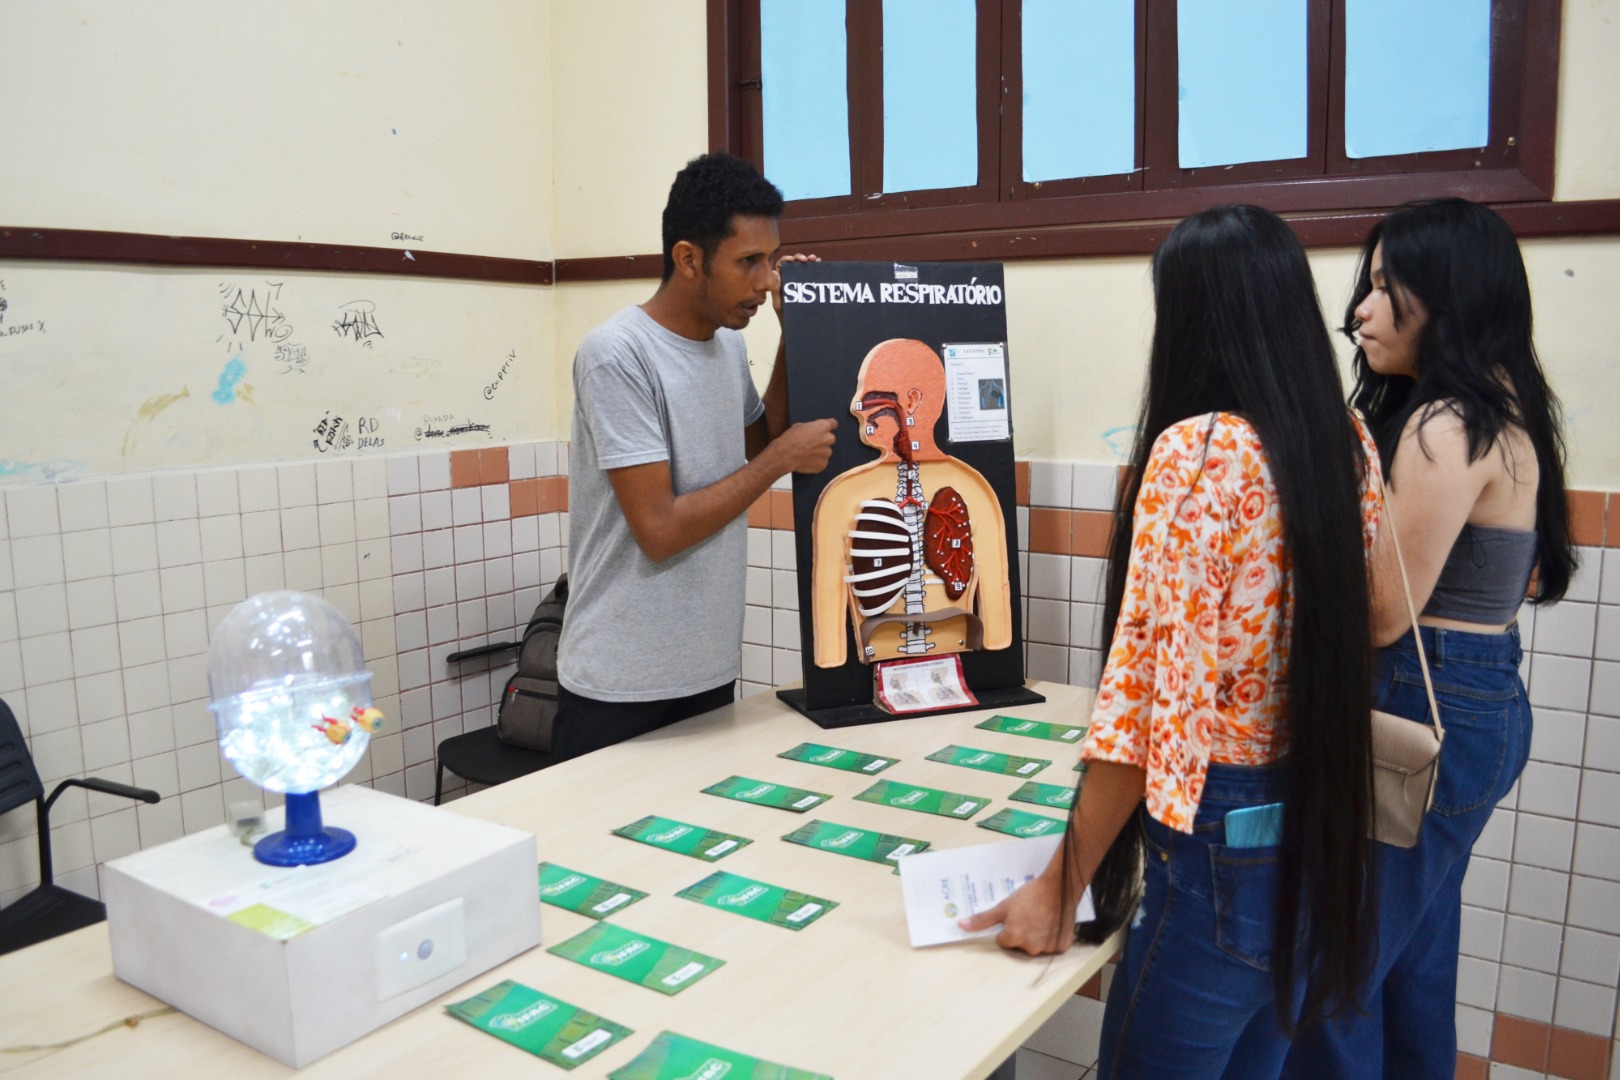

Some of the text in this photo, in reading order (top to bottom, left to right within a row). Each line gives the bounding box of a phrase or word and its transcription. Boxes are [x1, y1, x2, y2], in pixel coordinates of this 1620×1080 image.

[783, 277, 1002, 305] SISTEMA RESPIRATÓRIO
[358, 416, 380, 435] RD
[357, 436, 385, 450] DELAS
